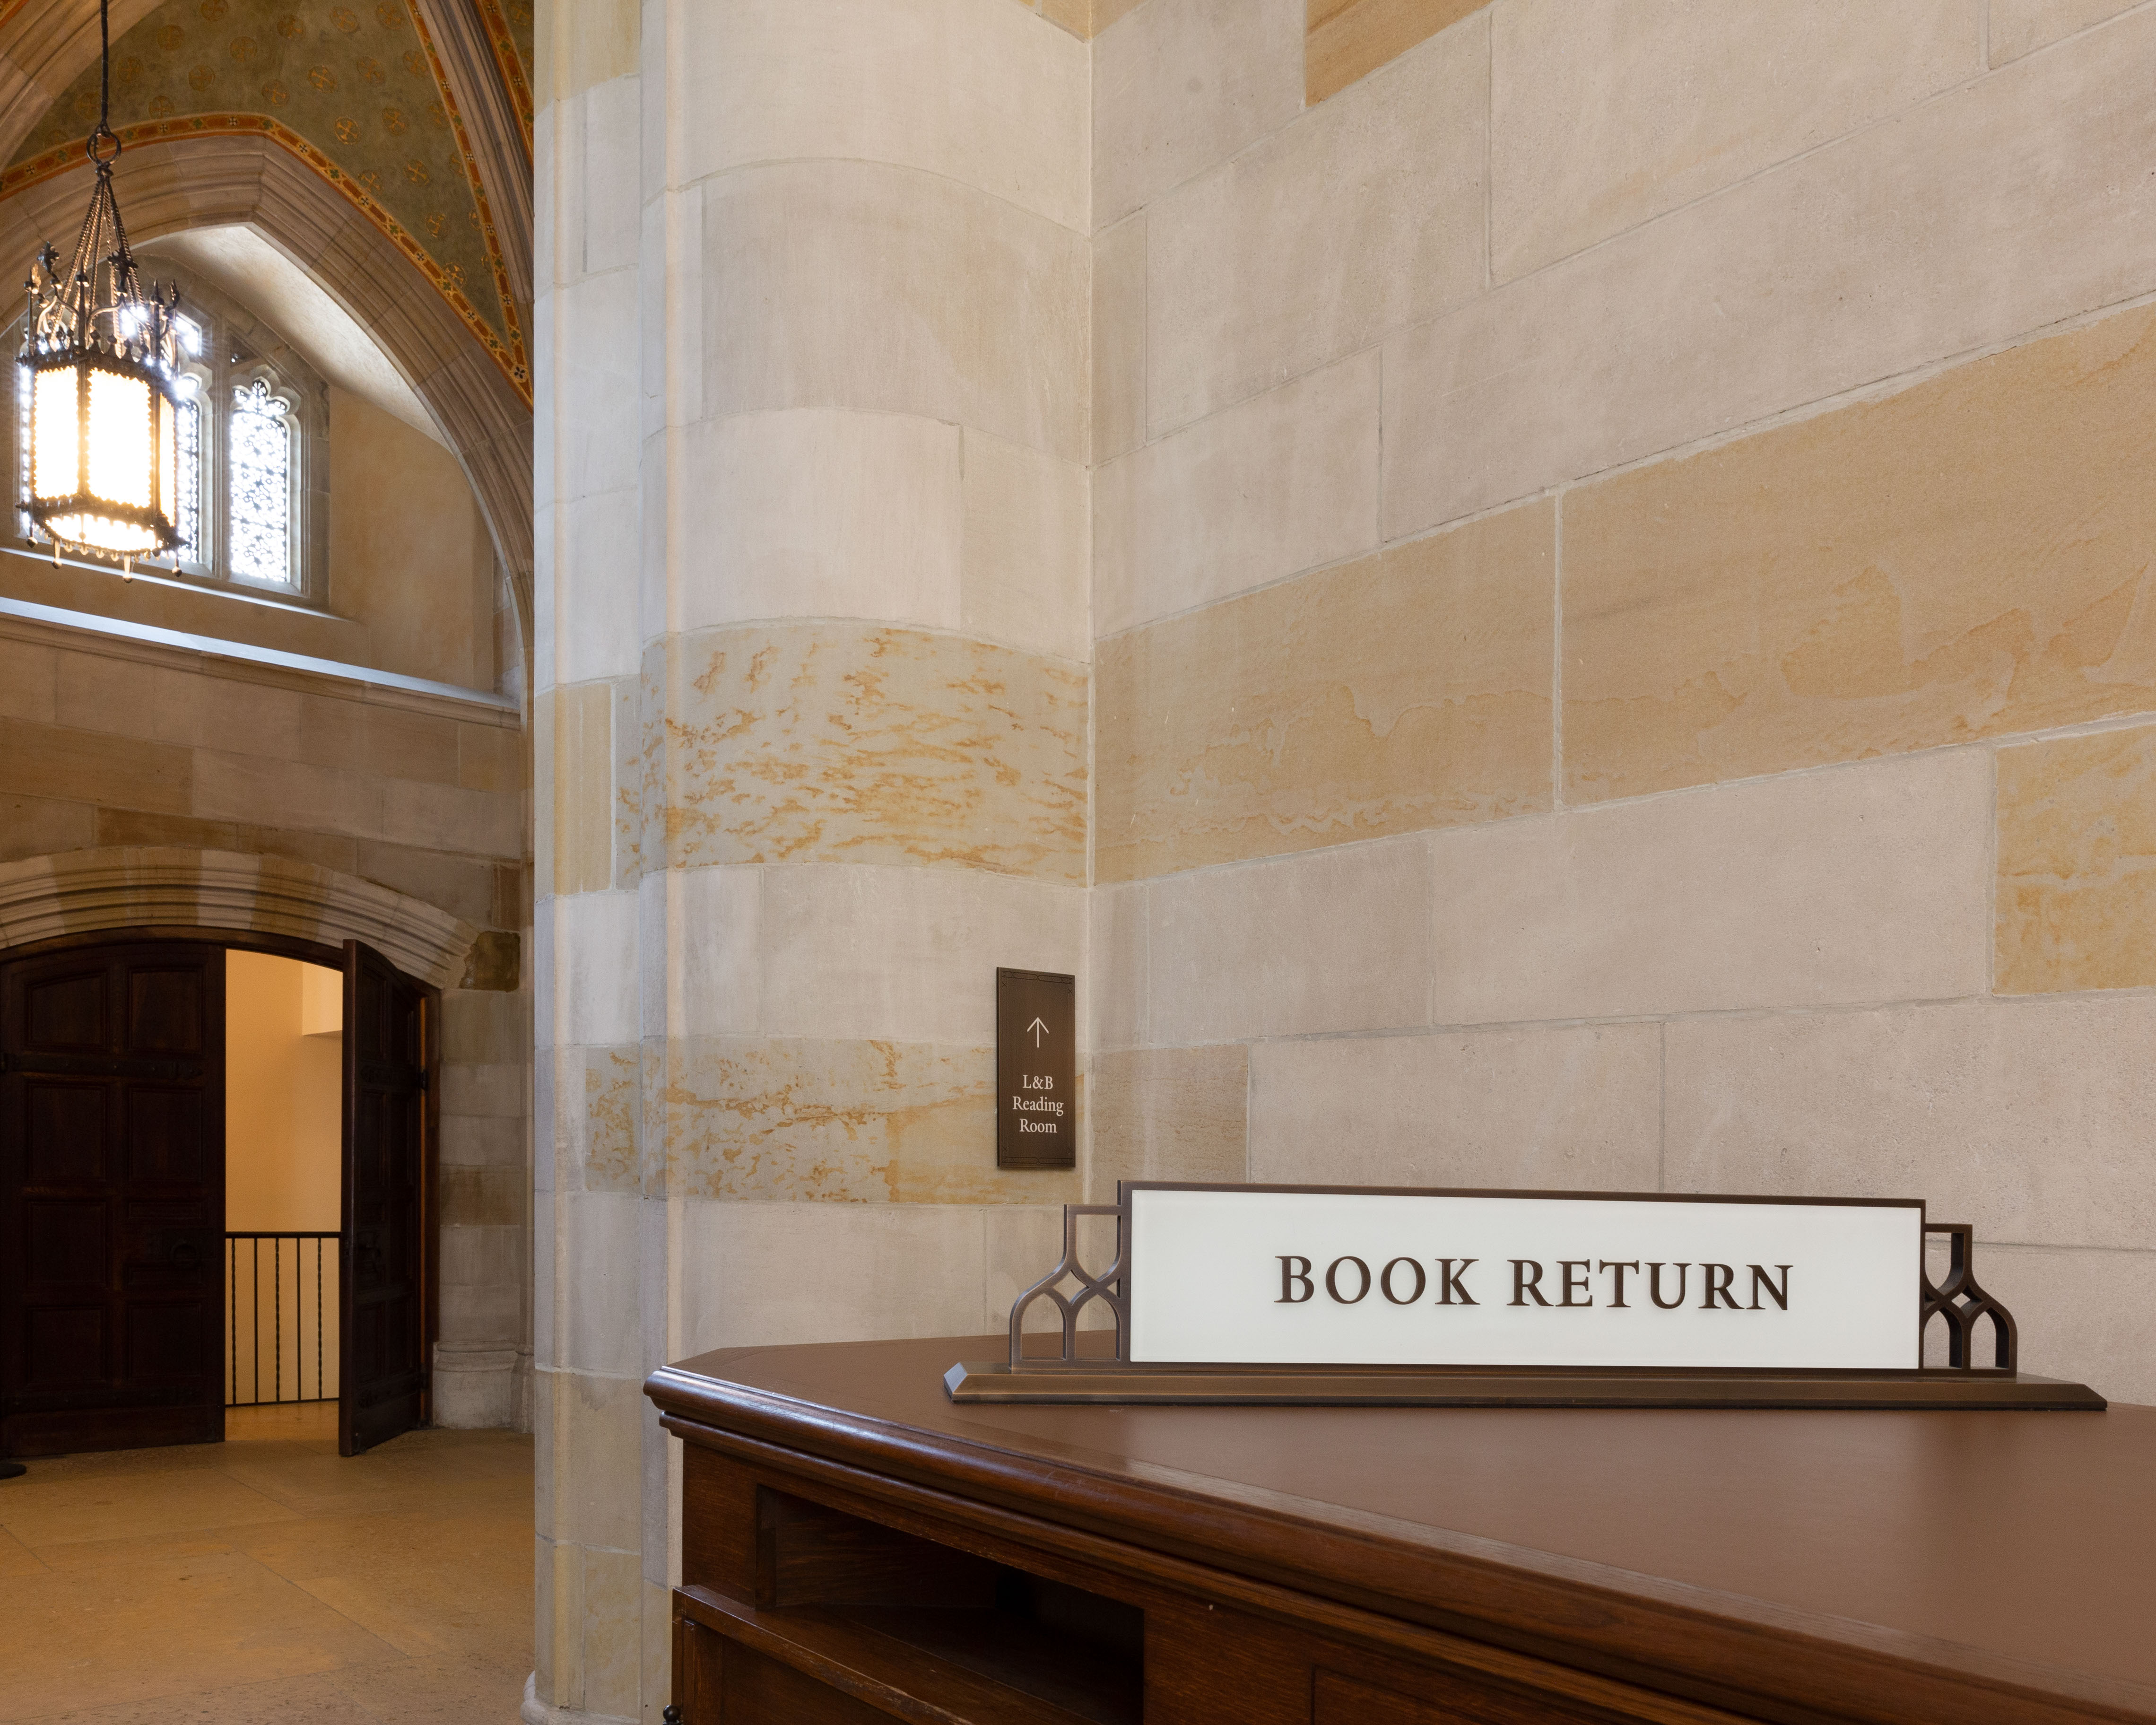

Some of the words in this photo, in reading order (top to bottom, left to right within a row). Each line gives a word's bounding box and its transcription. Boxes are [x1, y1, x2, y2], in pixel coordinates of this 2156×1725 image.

[1022, 1074, 1053, 1089] L&B
[1012, 1096, 1064, 1116] Reading
[1019, 1118, 1057, 1133] Room
[1273, 1255, 1481, 1305] BOOK
[1506, 1258, 1794, 1311] RETURN
